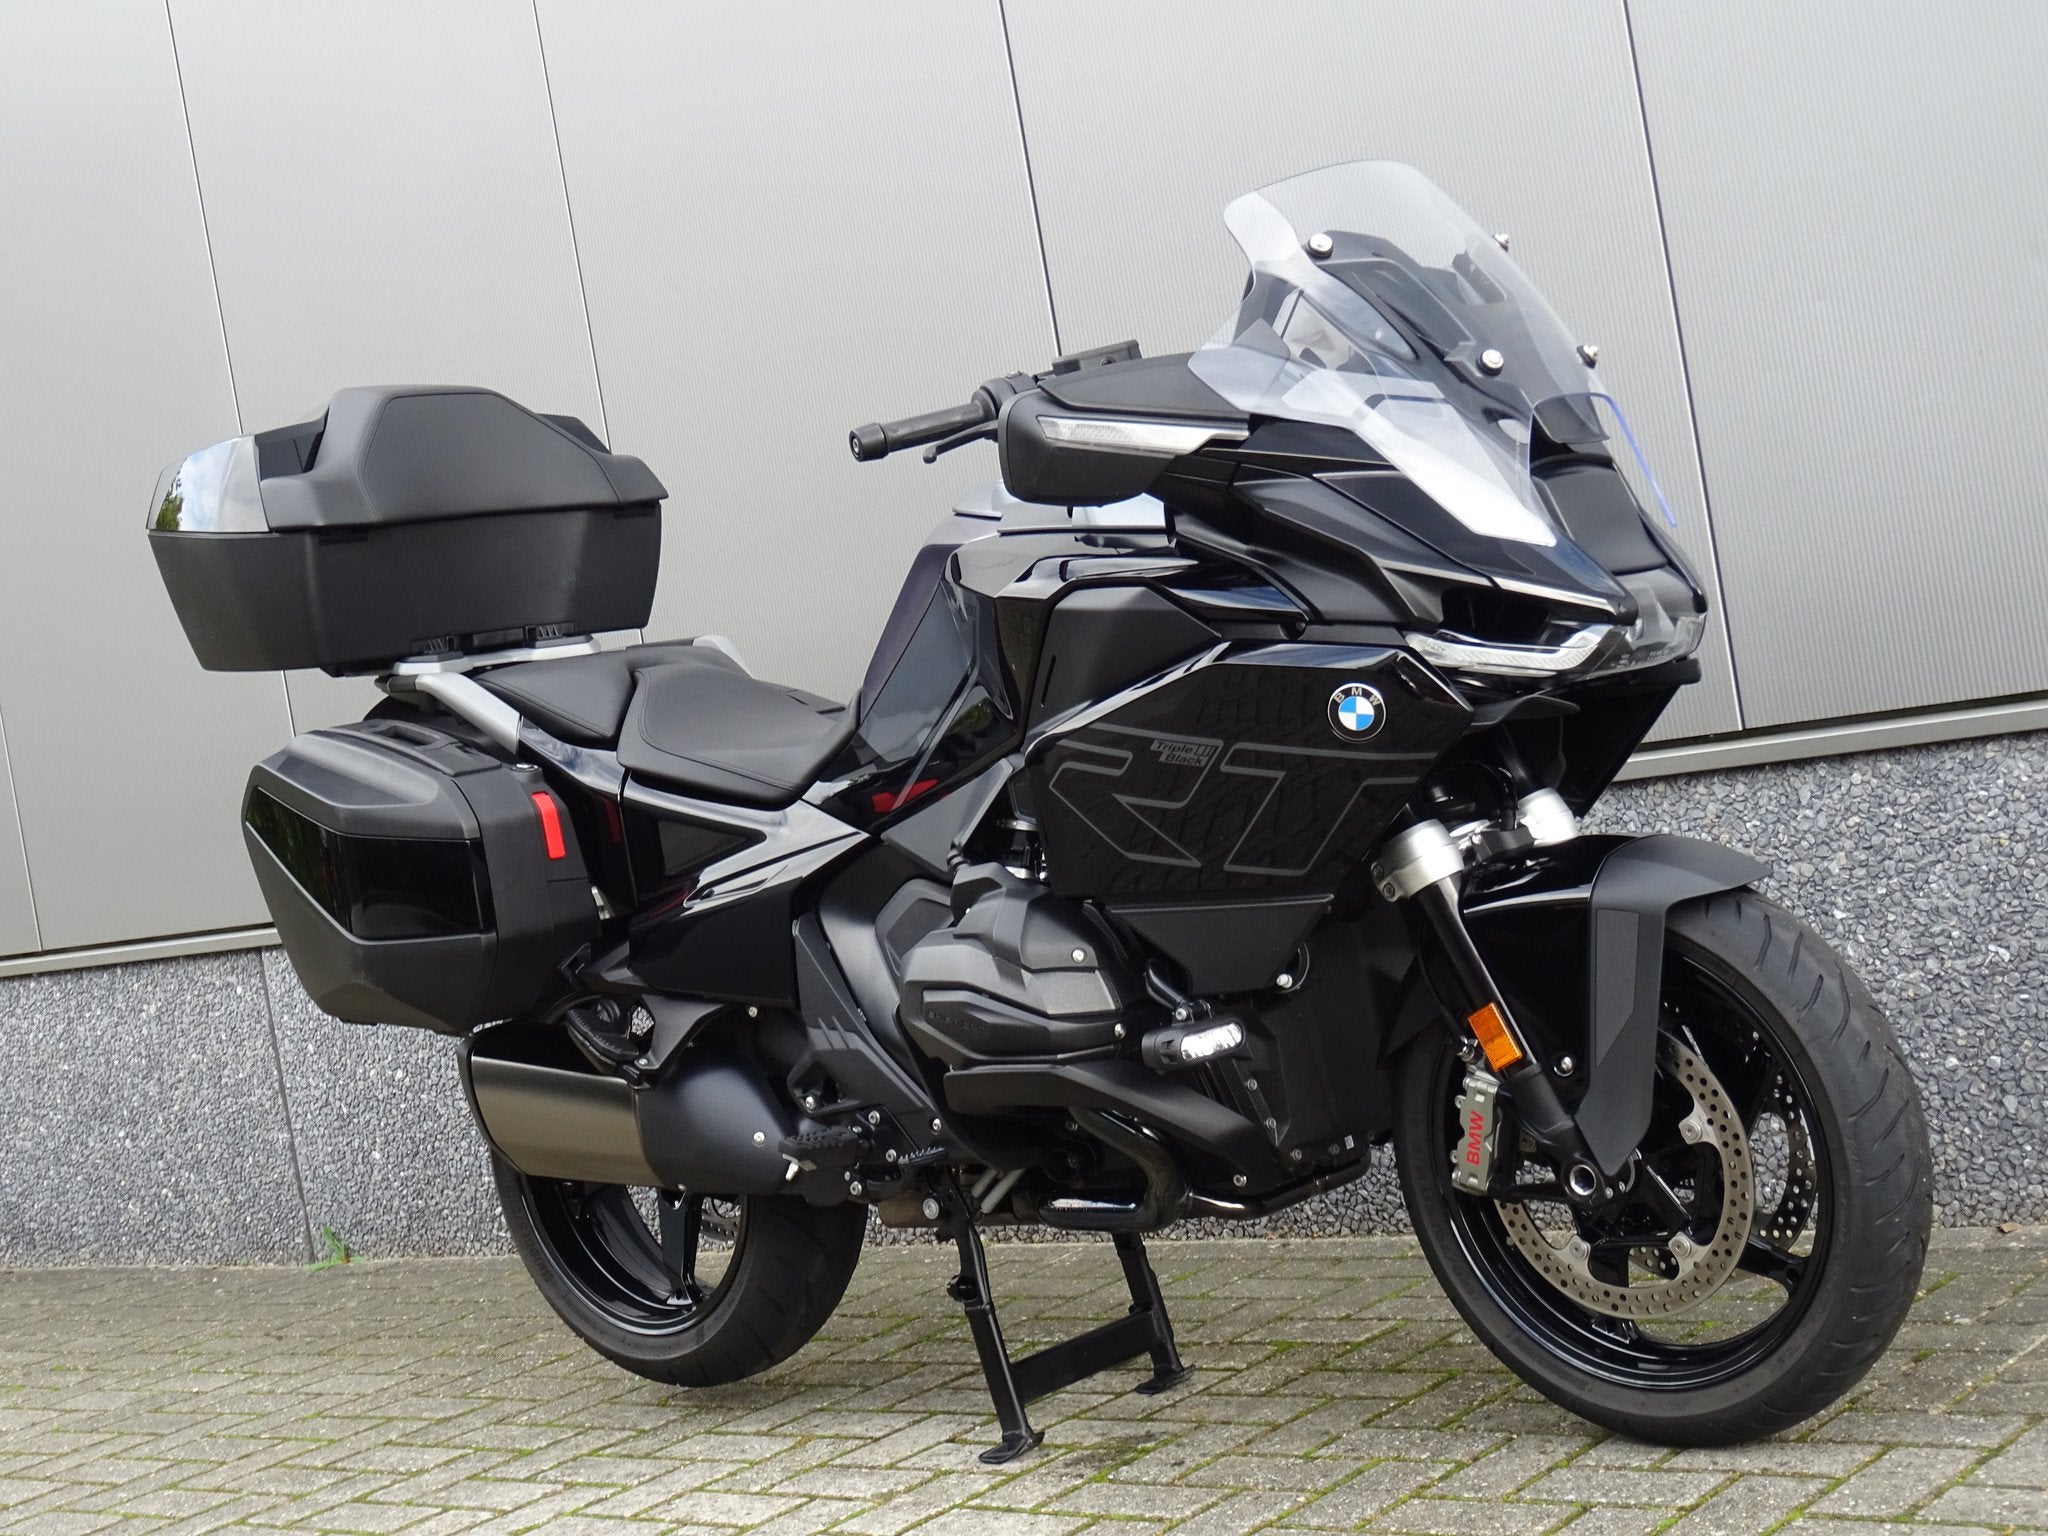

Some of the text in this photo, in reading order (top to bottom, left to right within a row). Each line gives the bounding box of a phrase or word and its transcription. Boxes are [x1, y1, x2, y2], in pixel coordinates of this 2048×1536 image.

[1333, 686, 1381, 706] BMW
[1156, 741, 1193, 755] Triple
[1165, 753, 1203, 765] Black
[1466, 1110, 1484, 1166] BMW
